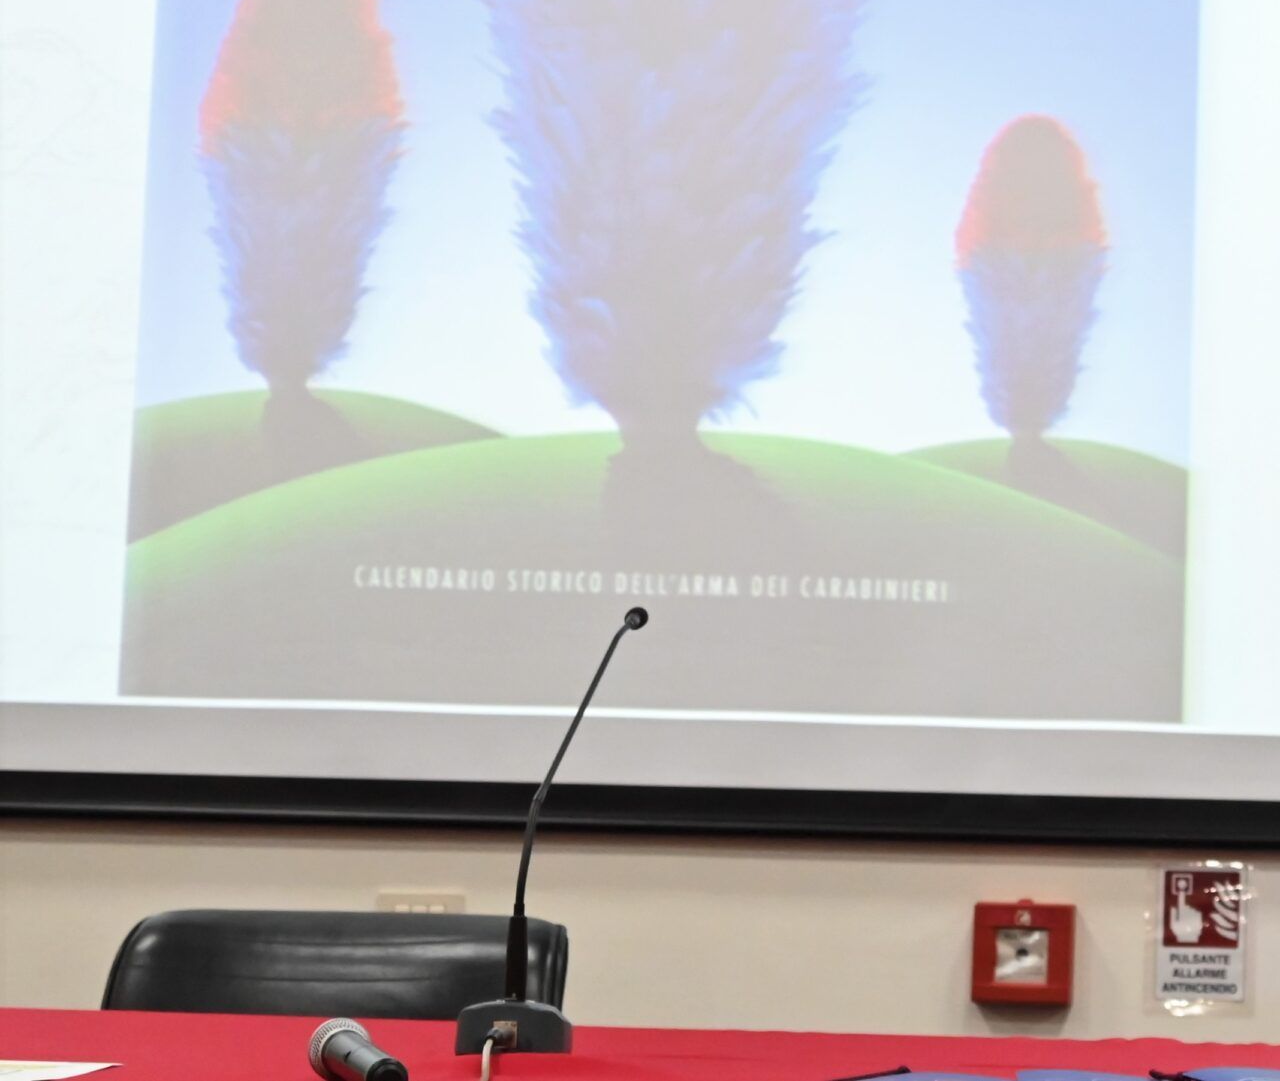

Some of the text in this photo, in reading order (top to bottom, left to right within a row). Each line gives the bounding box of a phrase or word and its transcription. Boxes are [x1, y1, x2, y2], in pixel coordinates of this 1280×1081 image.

[353, 565, 949, 602] CALENDARIO STORICO DELL'ARMA DEI CARABINIERI
[1169, 953, 1230, 965] PULSANTE
[1172, 968, 1227, 980] ALLARME
[1162, 982, 1238, 995] ANTINCENDIO
